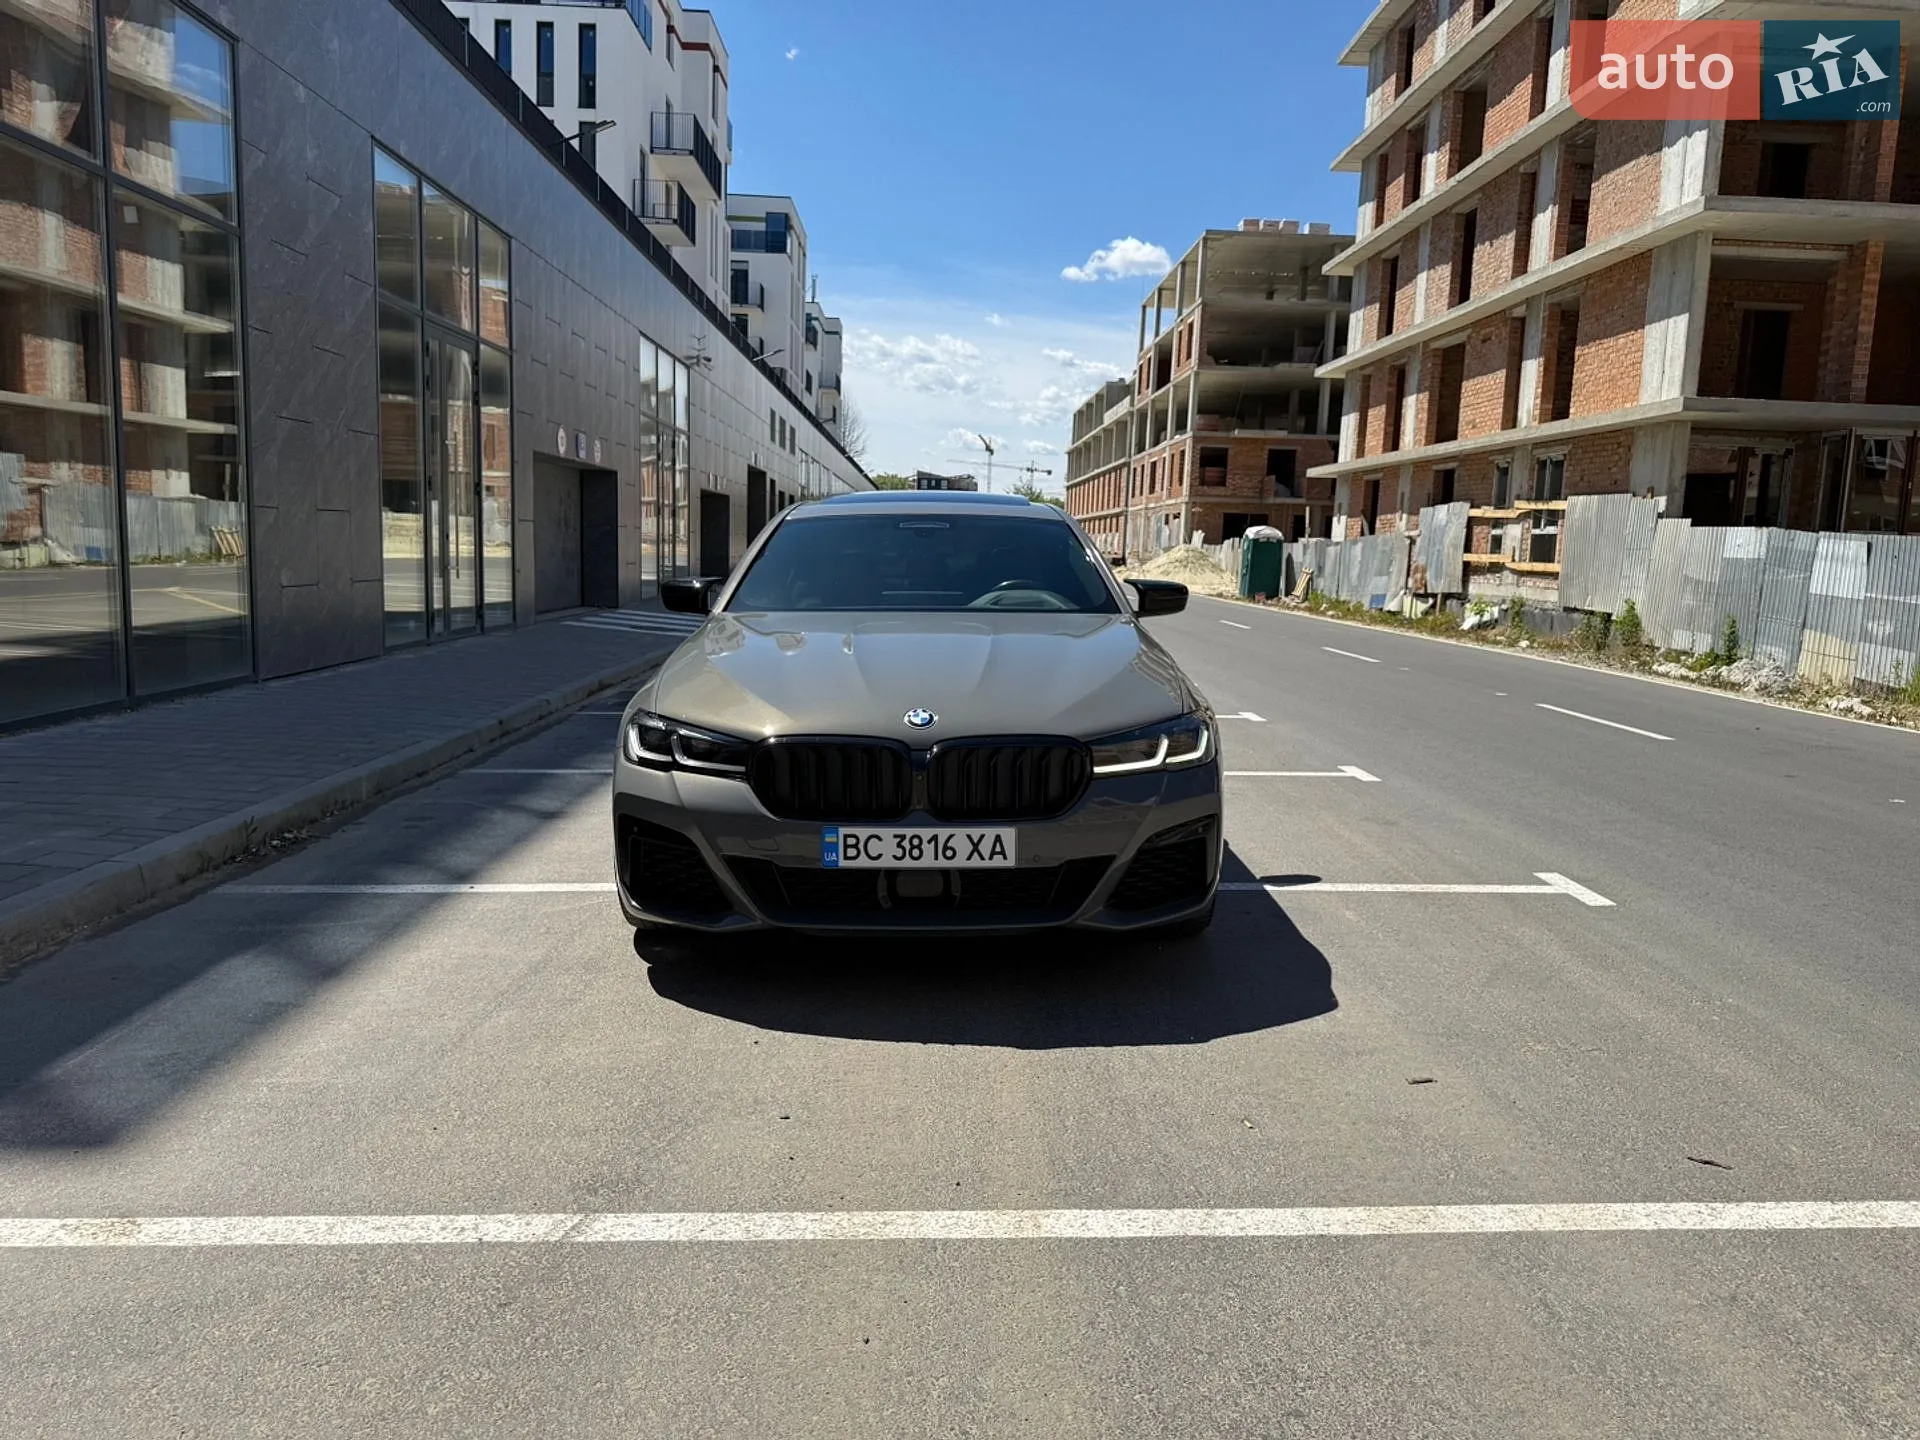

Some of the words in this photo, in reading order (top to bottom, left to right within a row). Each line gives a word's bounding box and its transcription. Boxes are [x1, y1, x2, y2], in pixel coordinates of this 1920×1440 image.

[842, 833, 884, 861] BC
[891, 833, 957, 861] 3816
[965, 833, 1008, 861] XA
[824, 852, 838, 861] UA
